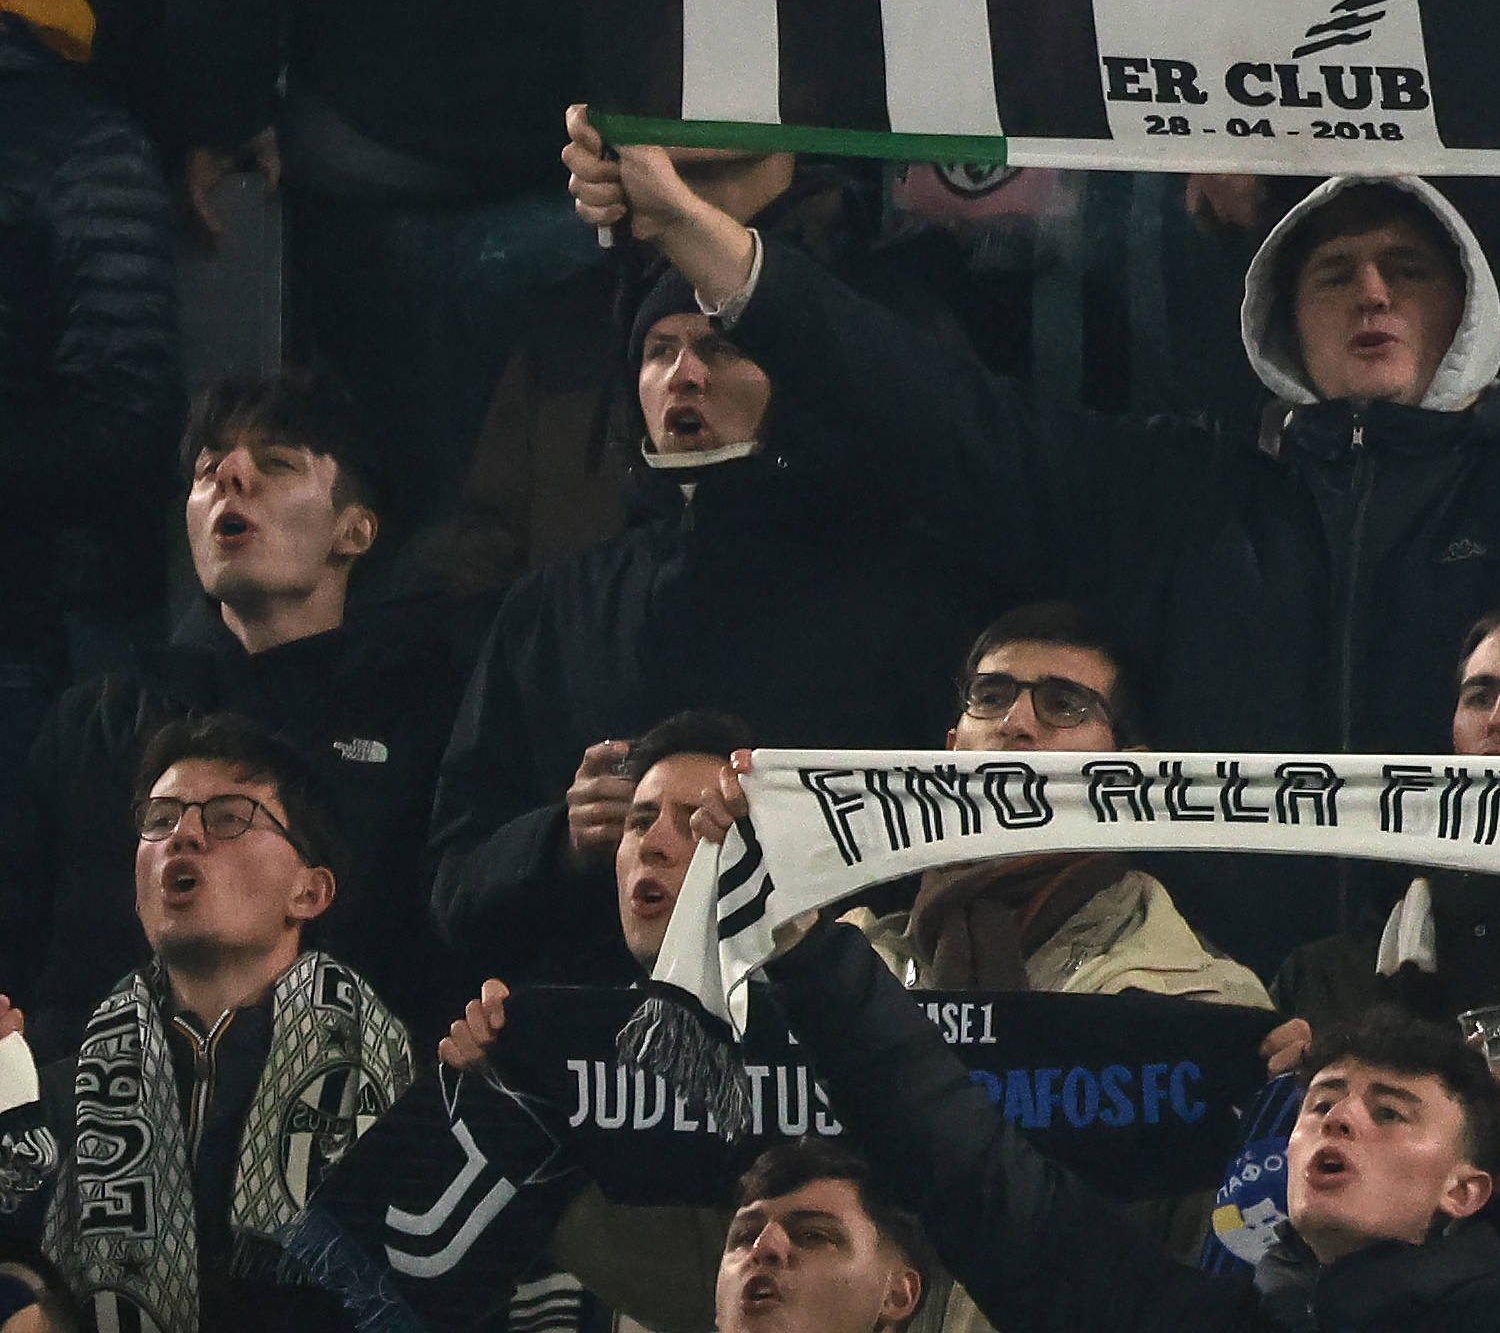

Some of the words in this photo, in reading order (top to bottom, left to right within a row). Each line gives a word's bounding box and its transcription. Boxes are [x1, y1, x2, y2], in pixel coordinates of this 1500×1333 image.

[1224, 61, 1431, 111] CLUB
[1143, 114, 1192, 137] 28
[1225, 117, 1276, 138] 04
[1310, 119, 1405, 142] 2018
[798, 759, 1055, 868] FINO
[1080, 758, 1343, 827] ALLA
[1139, 1060, 1208, 1125] FC
